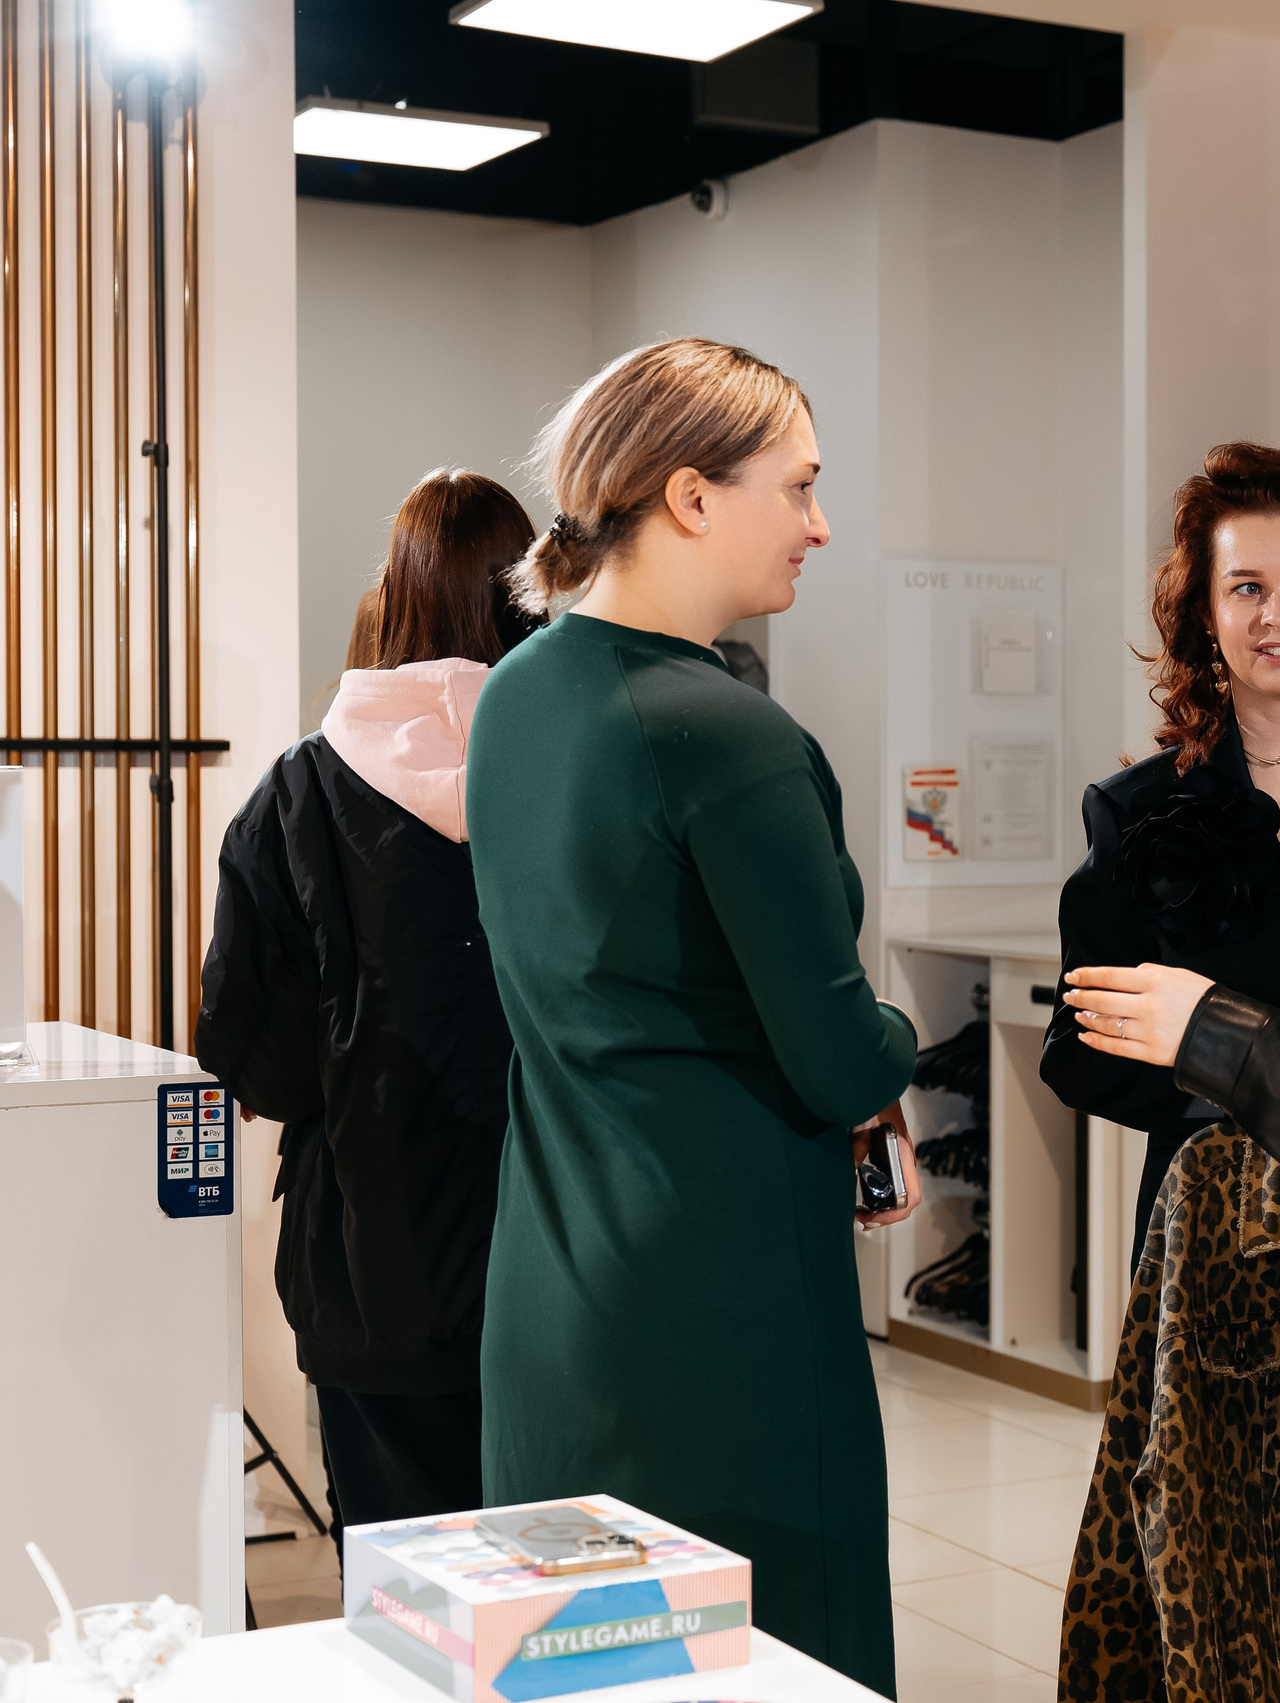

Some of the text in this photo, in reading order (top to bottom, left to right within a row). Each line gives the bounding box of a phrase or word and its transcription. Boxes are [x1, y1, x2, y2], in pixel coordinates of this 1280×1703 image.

[904, 571, 1044, 592] LOVE REPUBLIC
[199, 1186, 220, 1197] ВТБ
[526, 1611, 701, 1658] STYLEGAME.RU
